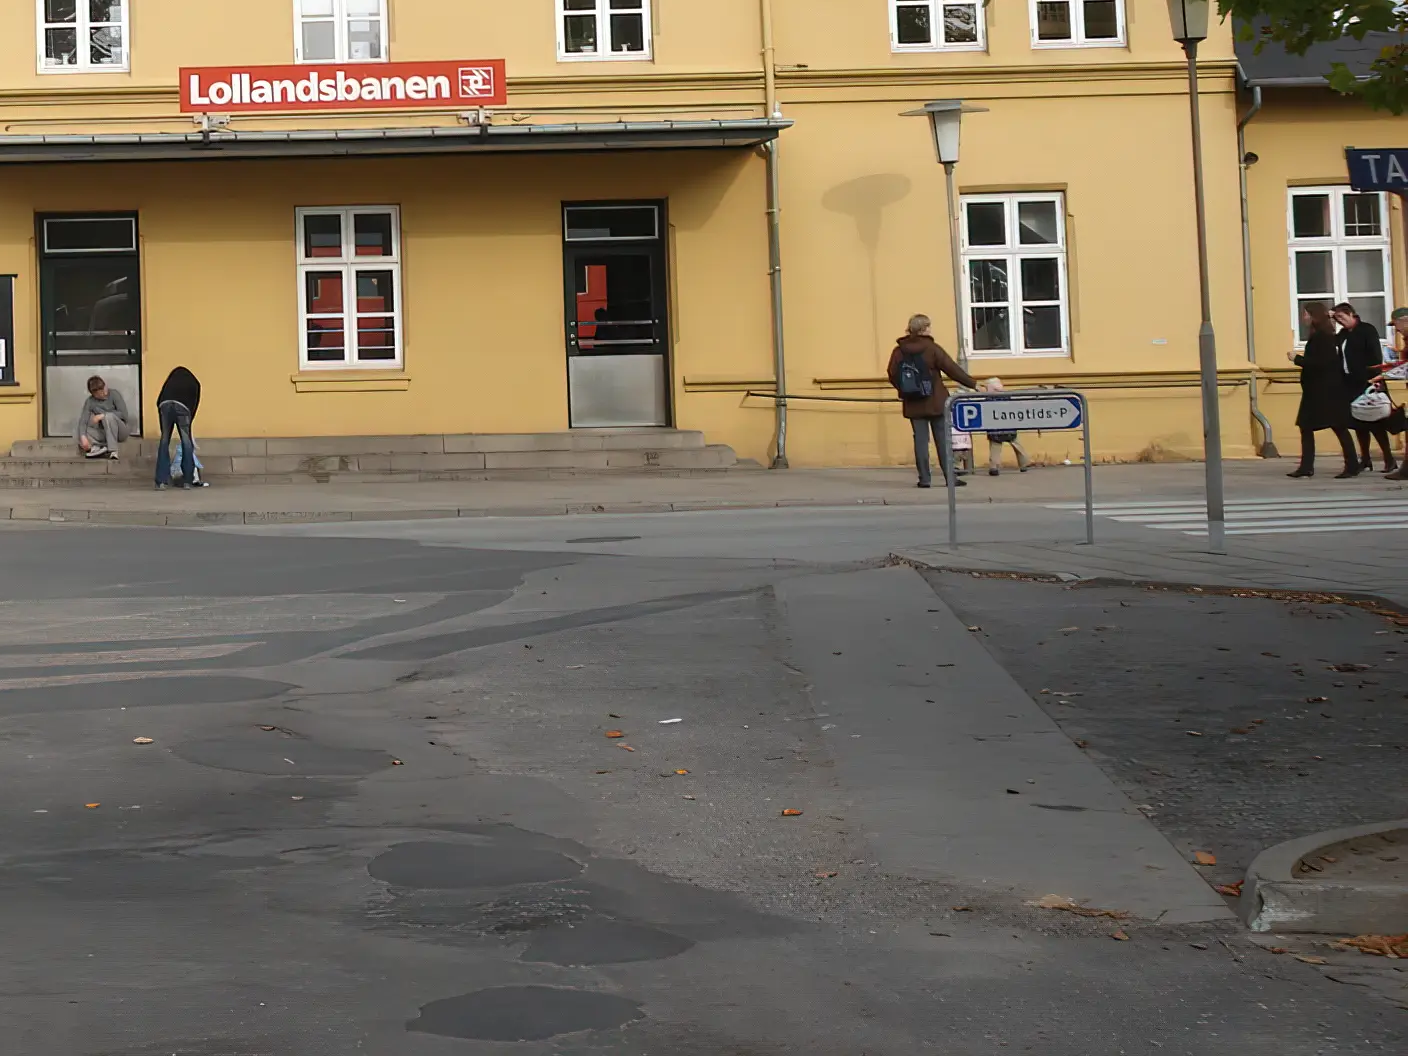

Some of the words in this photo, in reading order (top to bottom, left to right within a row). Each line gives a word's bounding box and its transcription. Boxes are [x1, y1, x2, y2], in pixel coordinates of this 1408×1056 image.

[189, 70, 451, 105] Lollandsbanen
[963, 405, 979, 427] P
[992, 407, 1068, 422] Langtids-P
